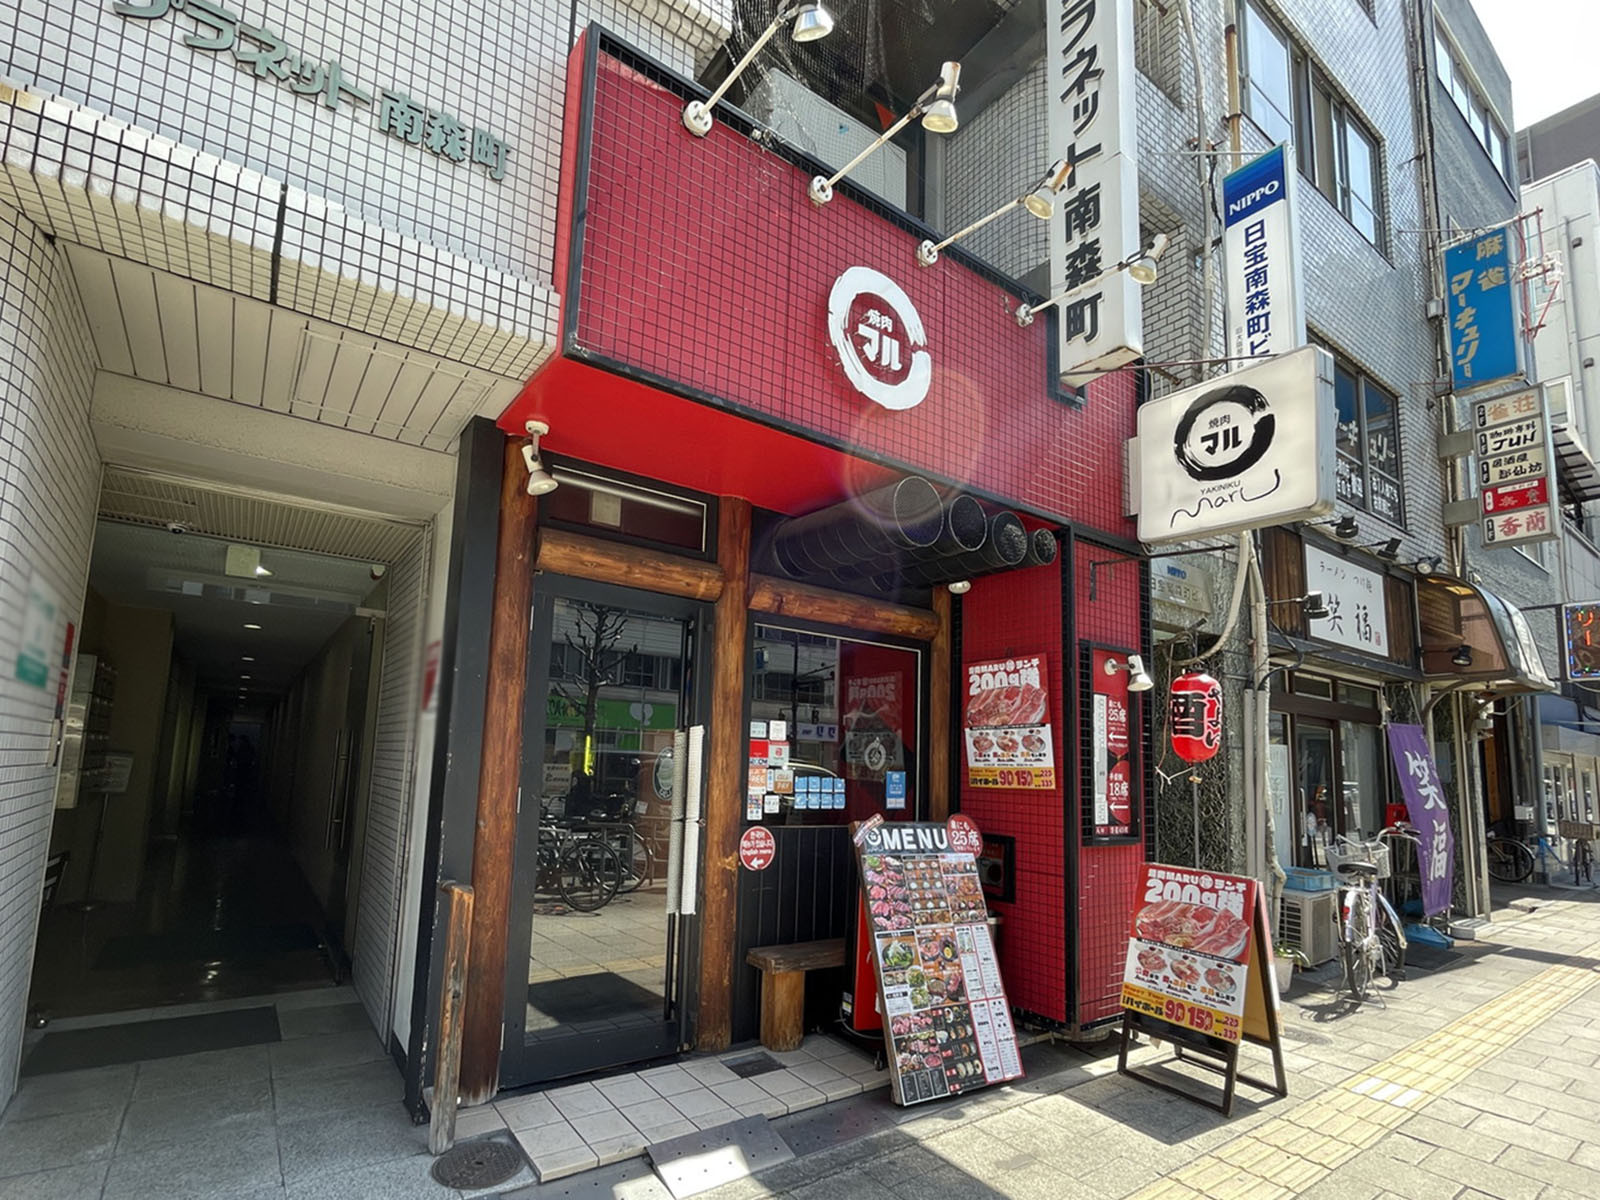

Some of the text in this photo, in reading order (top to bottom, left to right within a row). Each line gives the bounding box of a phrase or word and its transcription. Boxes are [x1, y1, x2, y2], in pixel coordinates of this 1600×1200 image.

[1060, 0, 1104, 343] ラネット南森町
[1229, 180, 1280, 216] NIPPO
[1476, 234, 1506, 292] 麻雀
[1244, 219, 1272, 362] 日宝南森町ビ
[1451, 269, 1480, 378] マーキュリー
[858, 323, 902, 371] マル
[1208, 414, 1231, 430] 焼肉
[1201, 425, 1242, 455] マル
[1200, 480, 1241, 495] YAKINIKU
[881, 828, 949, 850] MENU
[951, 830, 980, 846] 25席
[1165, 999, 1186, 1024] 90
